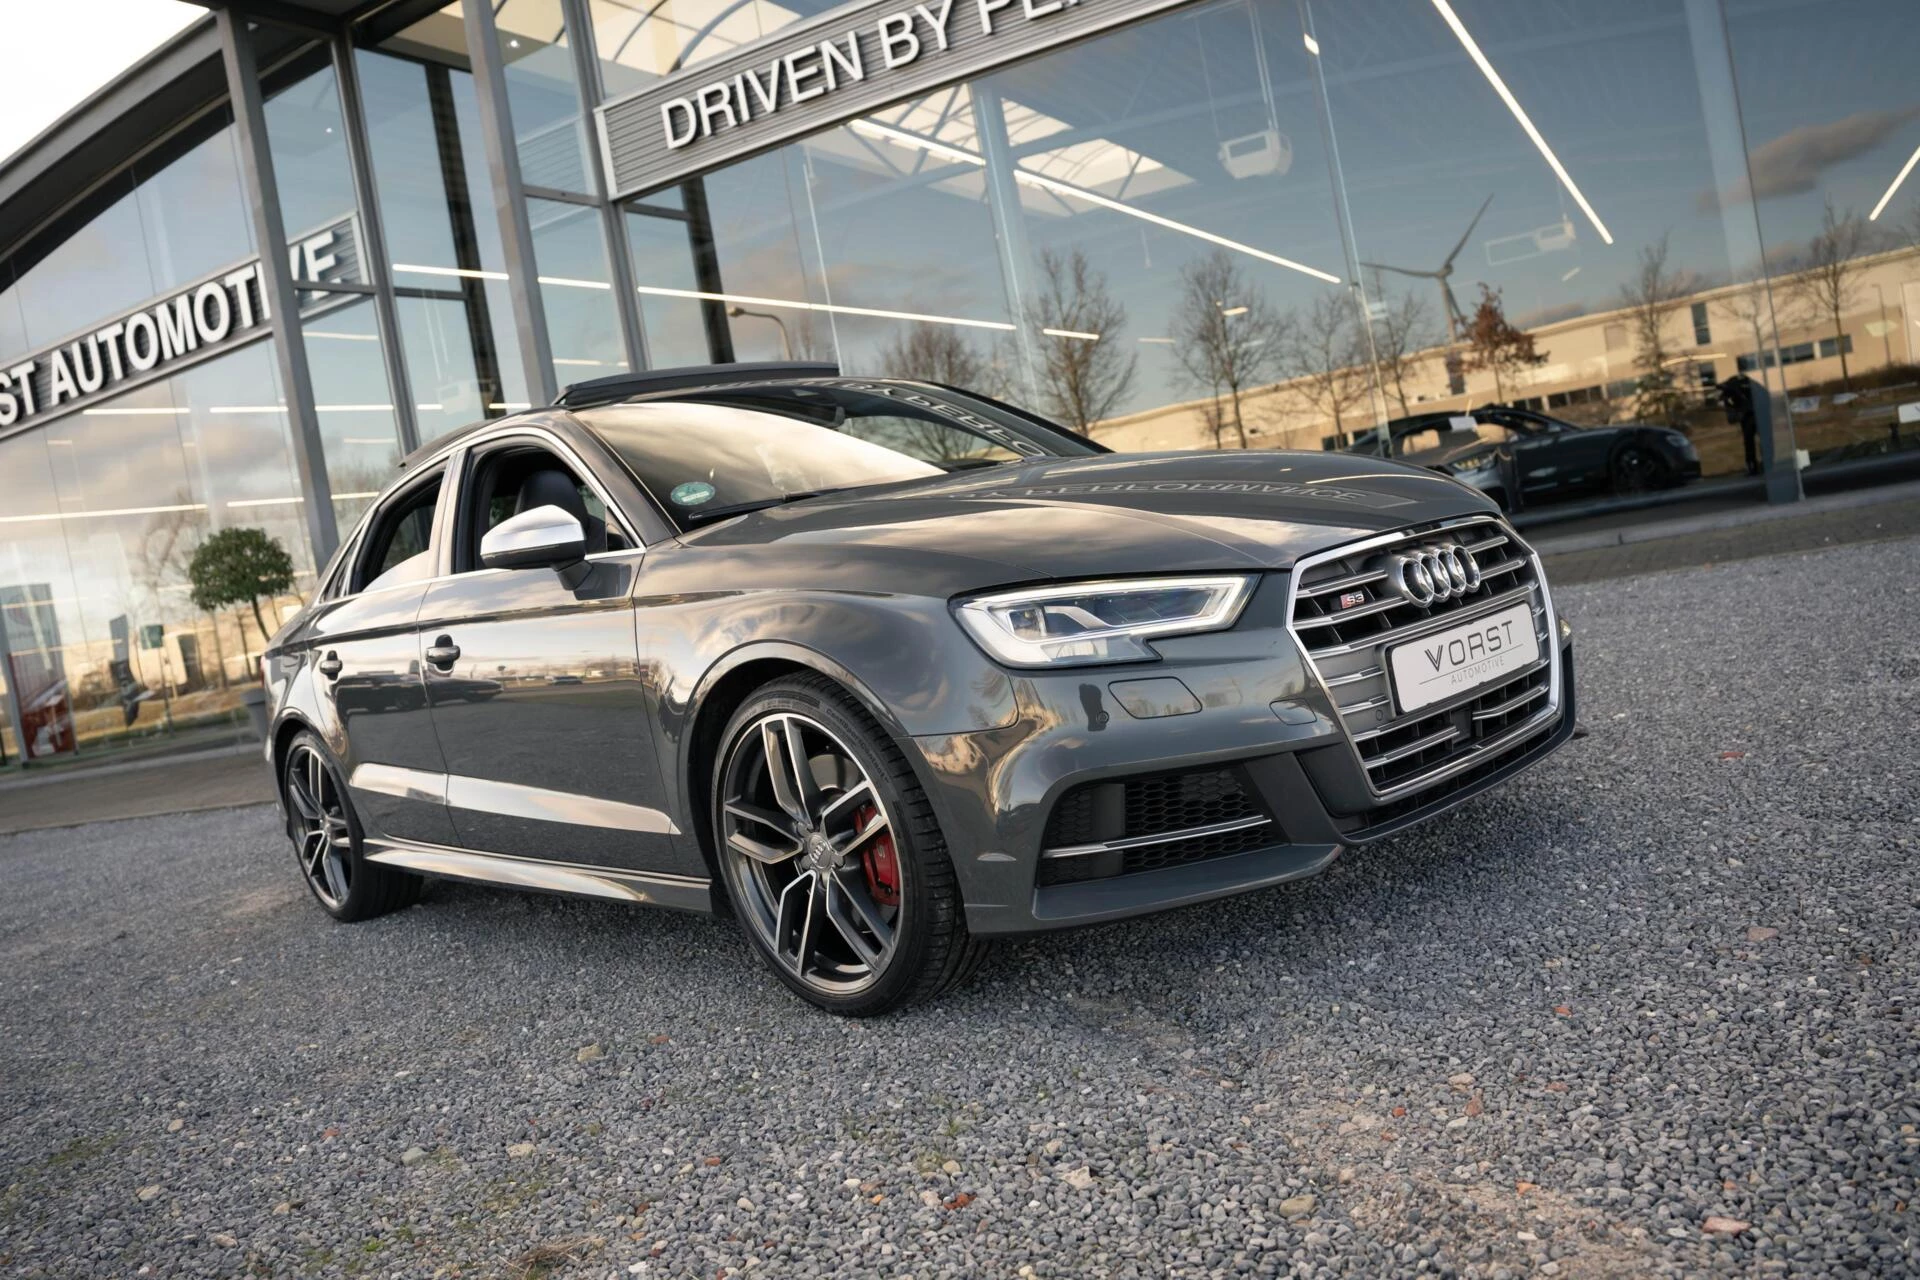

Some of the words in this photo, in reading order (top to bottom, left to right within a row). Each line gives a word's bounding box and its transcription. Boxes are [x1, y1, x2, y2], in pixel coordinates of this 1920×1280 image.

[660, 30, 865, 150] DRIVEN
[877, 0, 952, 70] BY
[1424, 620, 1513, 673] VORST
[1450, 655, 1505, 685] AUTOMOTIVE
